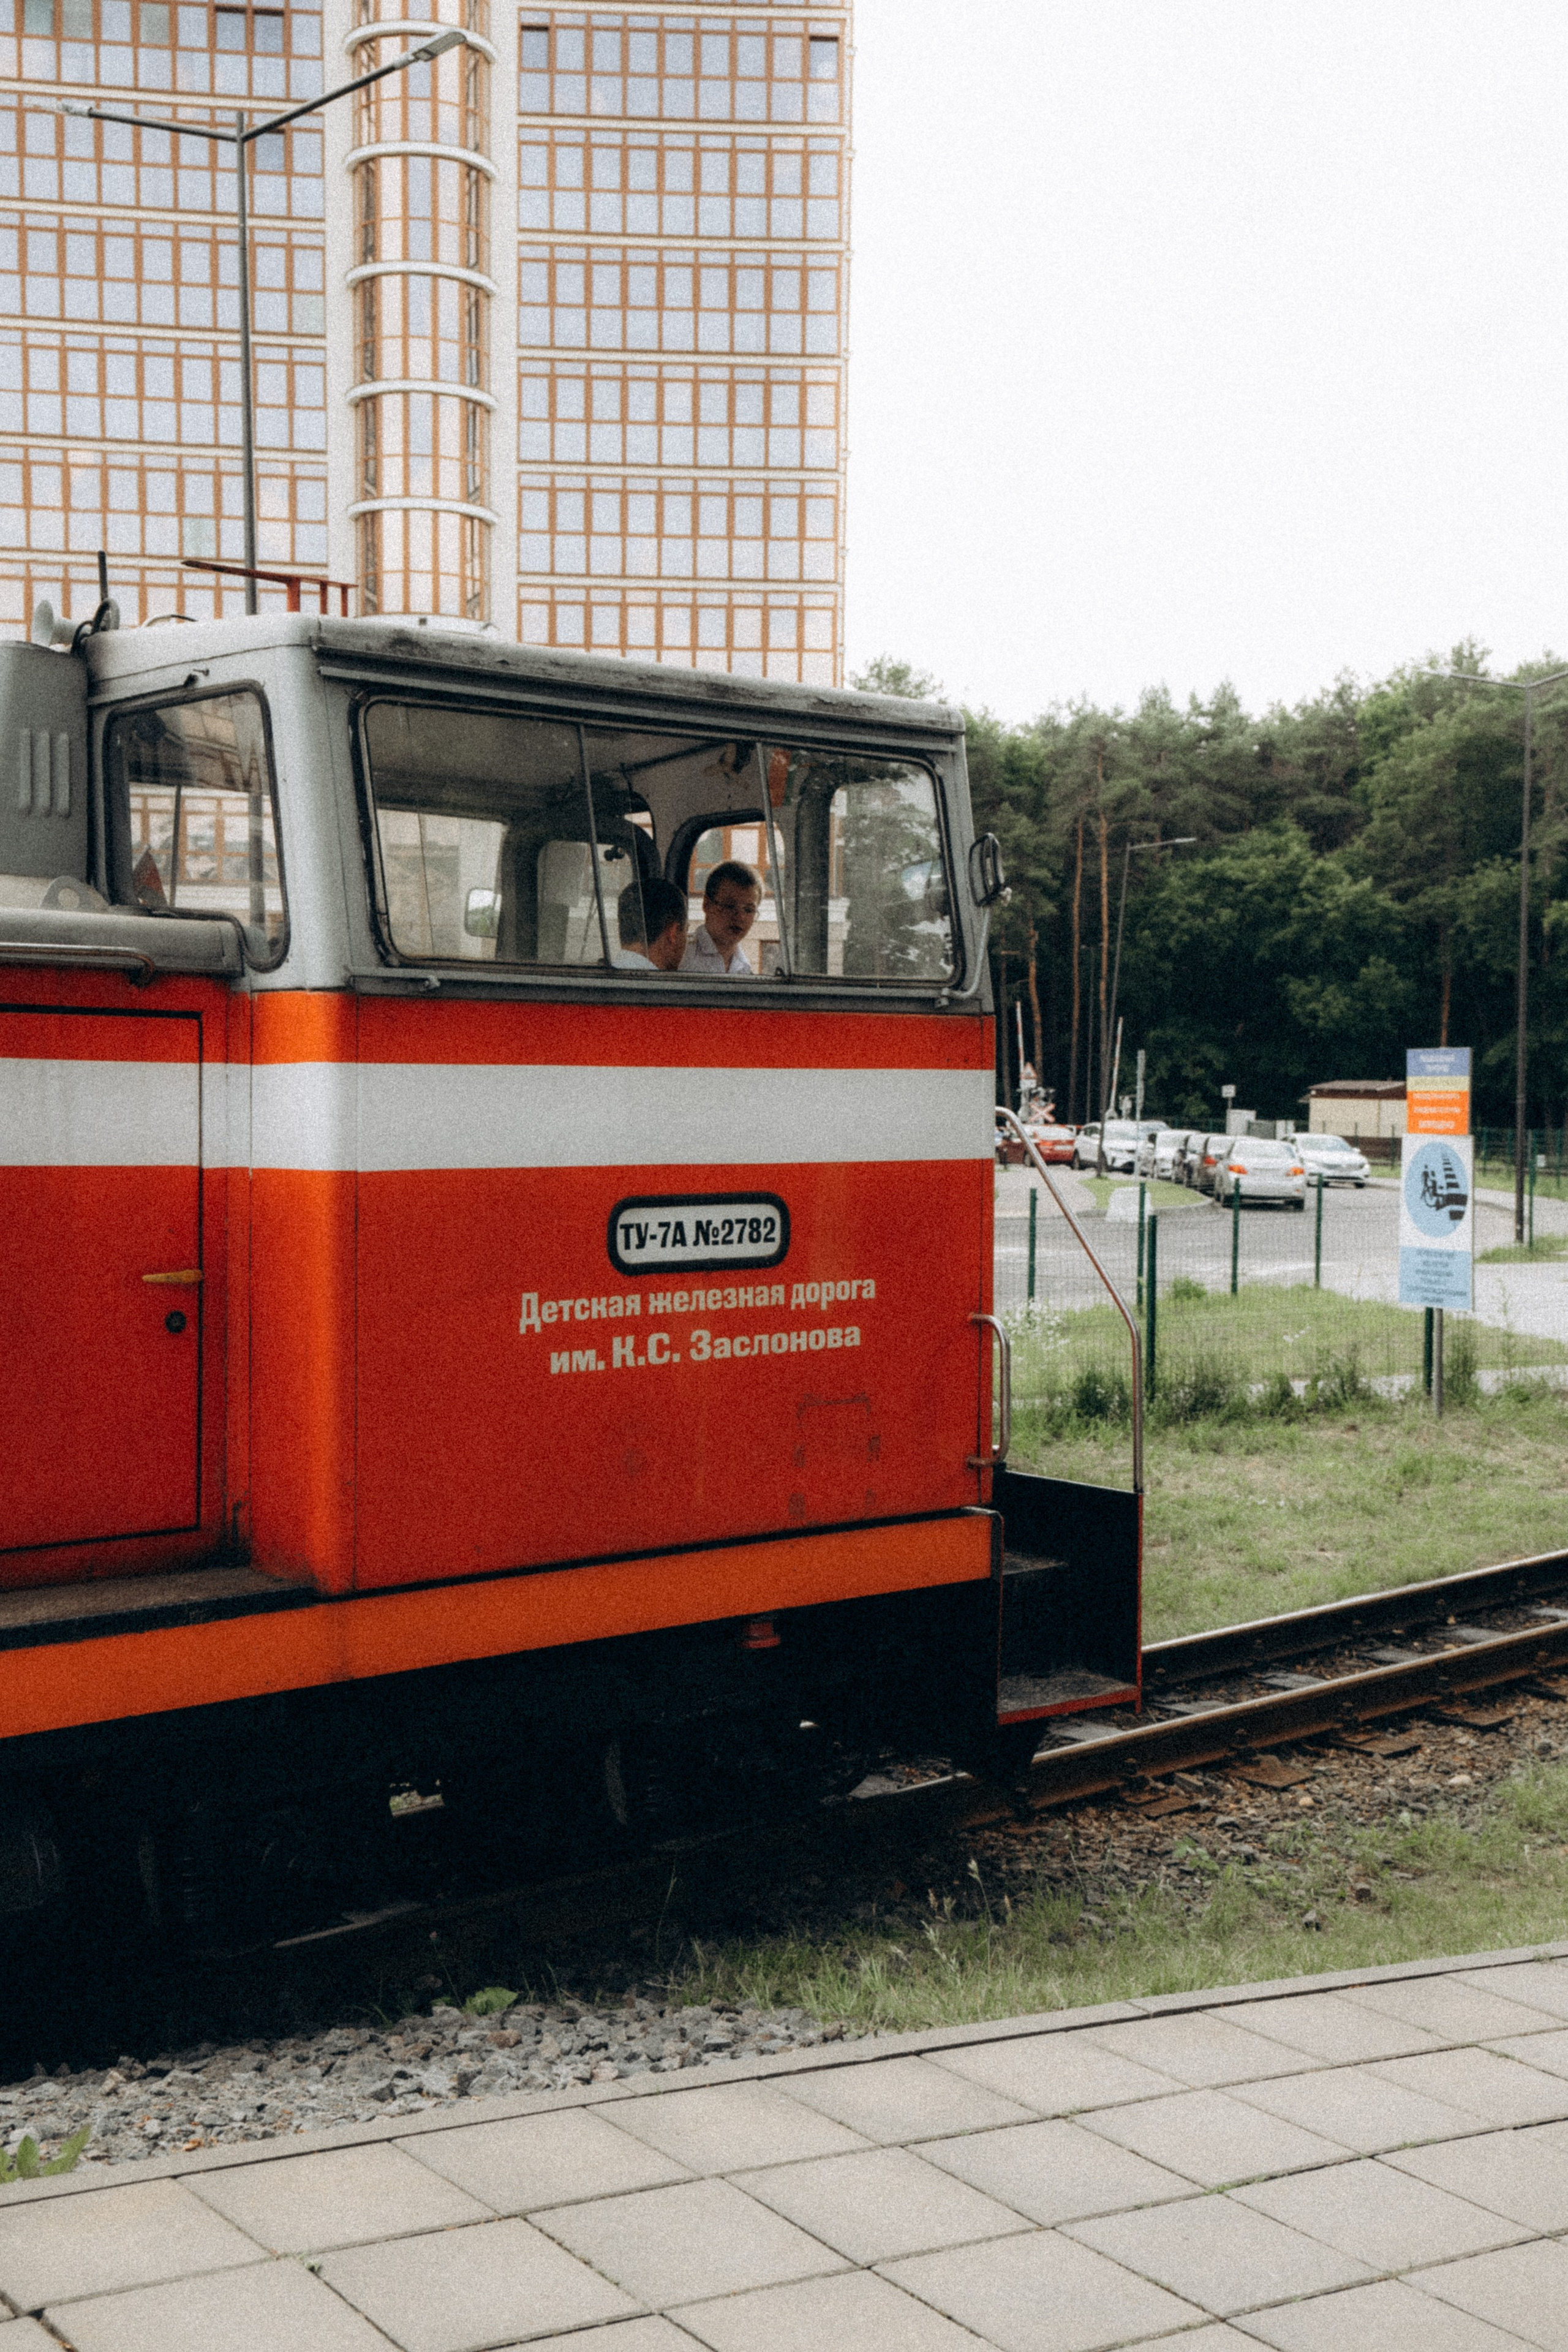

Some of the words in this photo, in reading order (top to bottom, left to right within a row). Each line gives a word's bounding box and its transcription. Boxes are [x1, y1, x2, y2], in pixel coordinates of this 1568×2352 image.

[619, 1221, 687, 1250] ТУ-7А
[692, 1216, 777, 1247] №2782
[519, 1292, 641, 1334] Детская
[648, 1284, 785, 1314] железная
[791, 1279, 876, 1310] дорога
[550, 1348, 606, 1374] им.
[612, 1333, 680, 1368] К.С.
[690, 1325, 861, 1361] Заслонова
